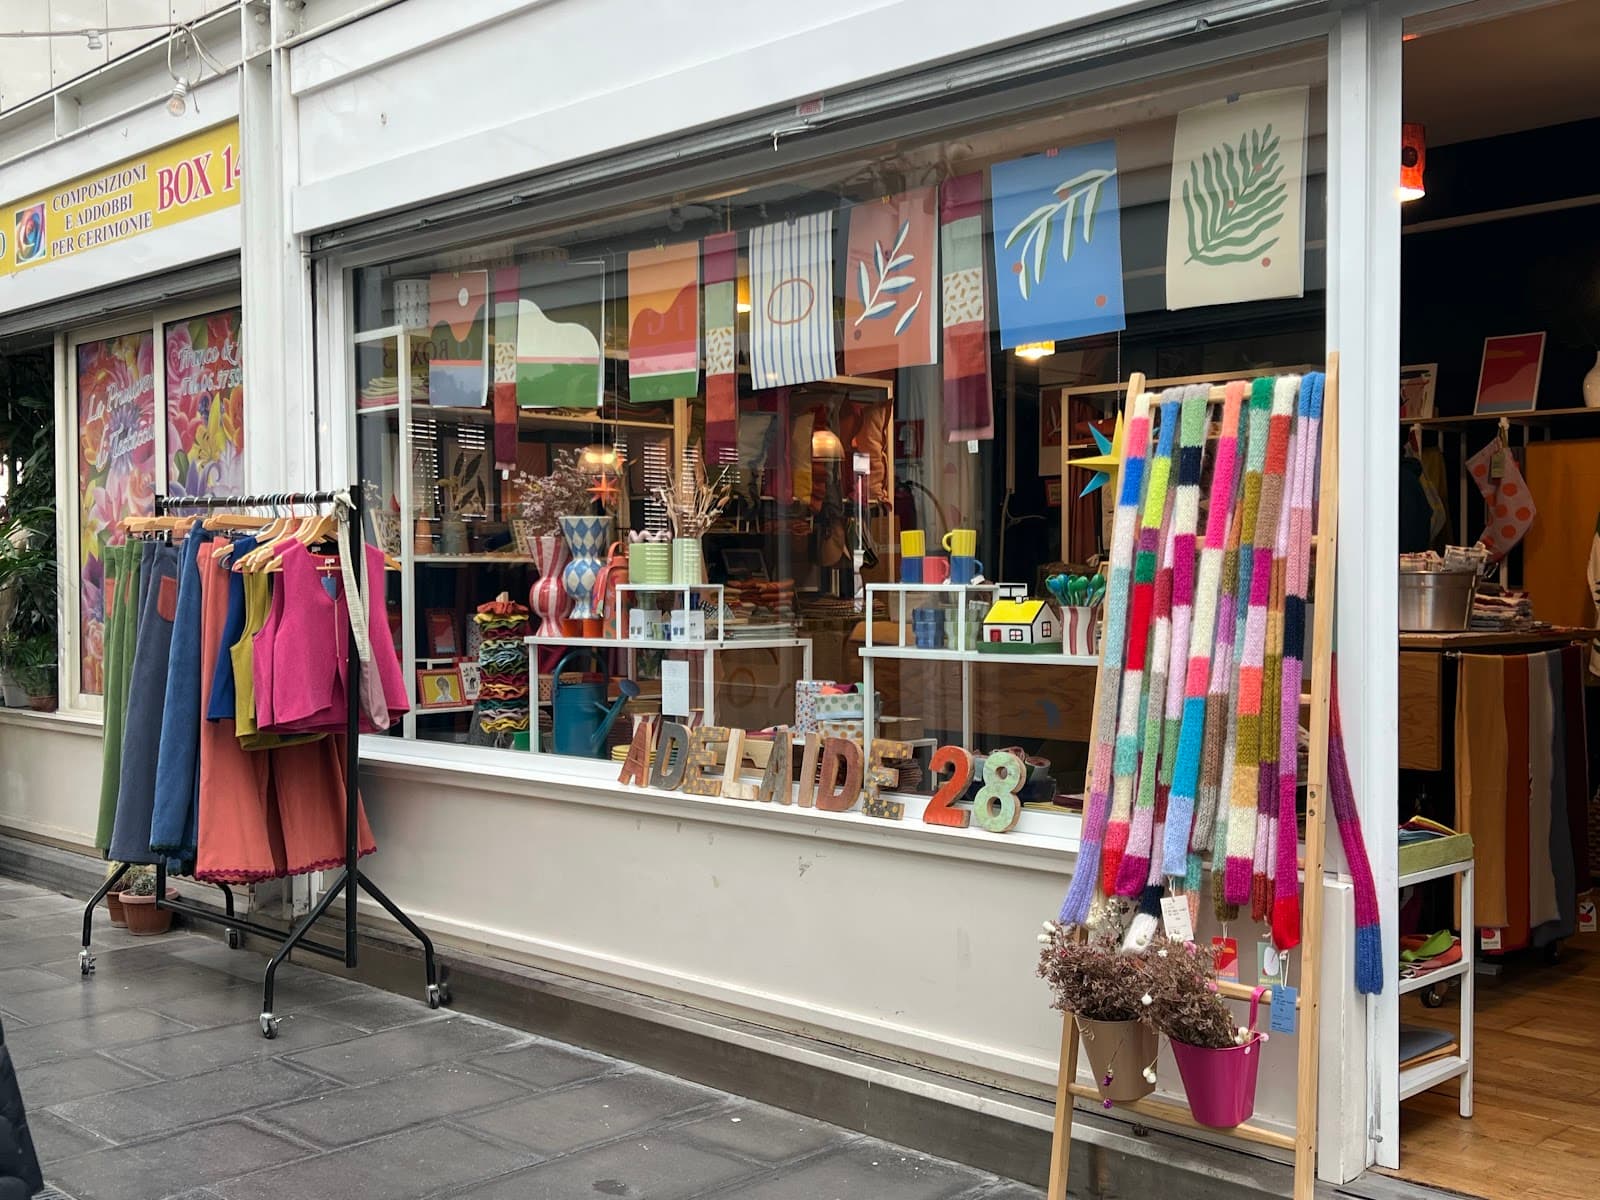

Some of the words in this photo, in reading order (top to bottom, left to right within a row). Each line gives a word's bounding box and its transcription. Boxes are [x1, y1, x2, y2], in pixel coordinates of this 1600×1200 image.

[52, 163, 148, 211] COMPOSIZIONI
[157, 152, 213, 212] BOX
[51, 234, 75, 258] PER
[77, 210, 152, 248] CERIMONIE
[65, 214, 74, 231] E
[75, 193, 133, 227] ADDOBBI
[86, 394, 105, 425] La
[617, 720, 914, 820] ADELAIDE
[923, 745, 1026, 833] 28
